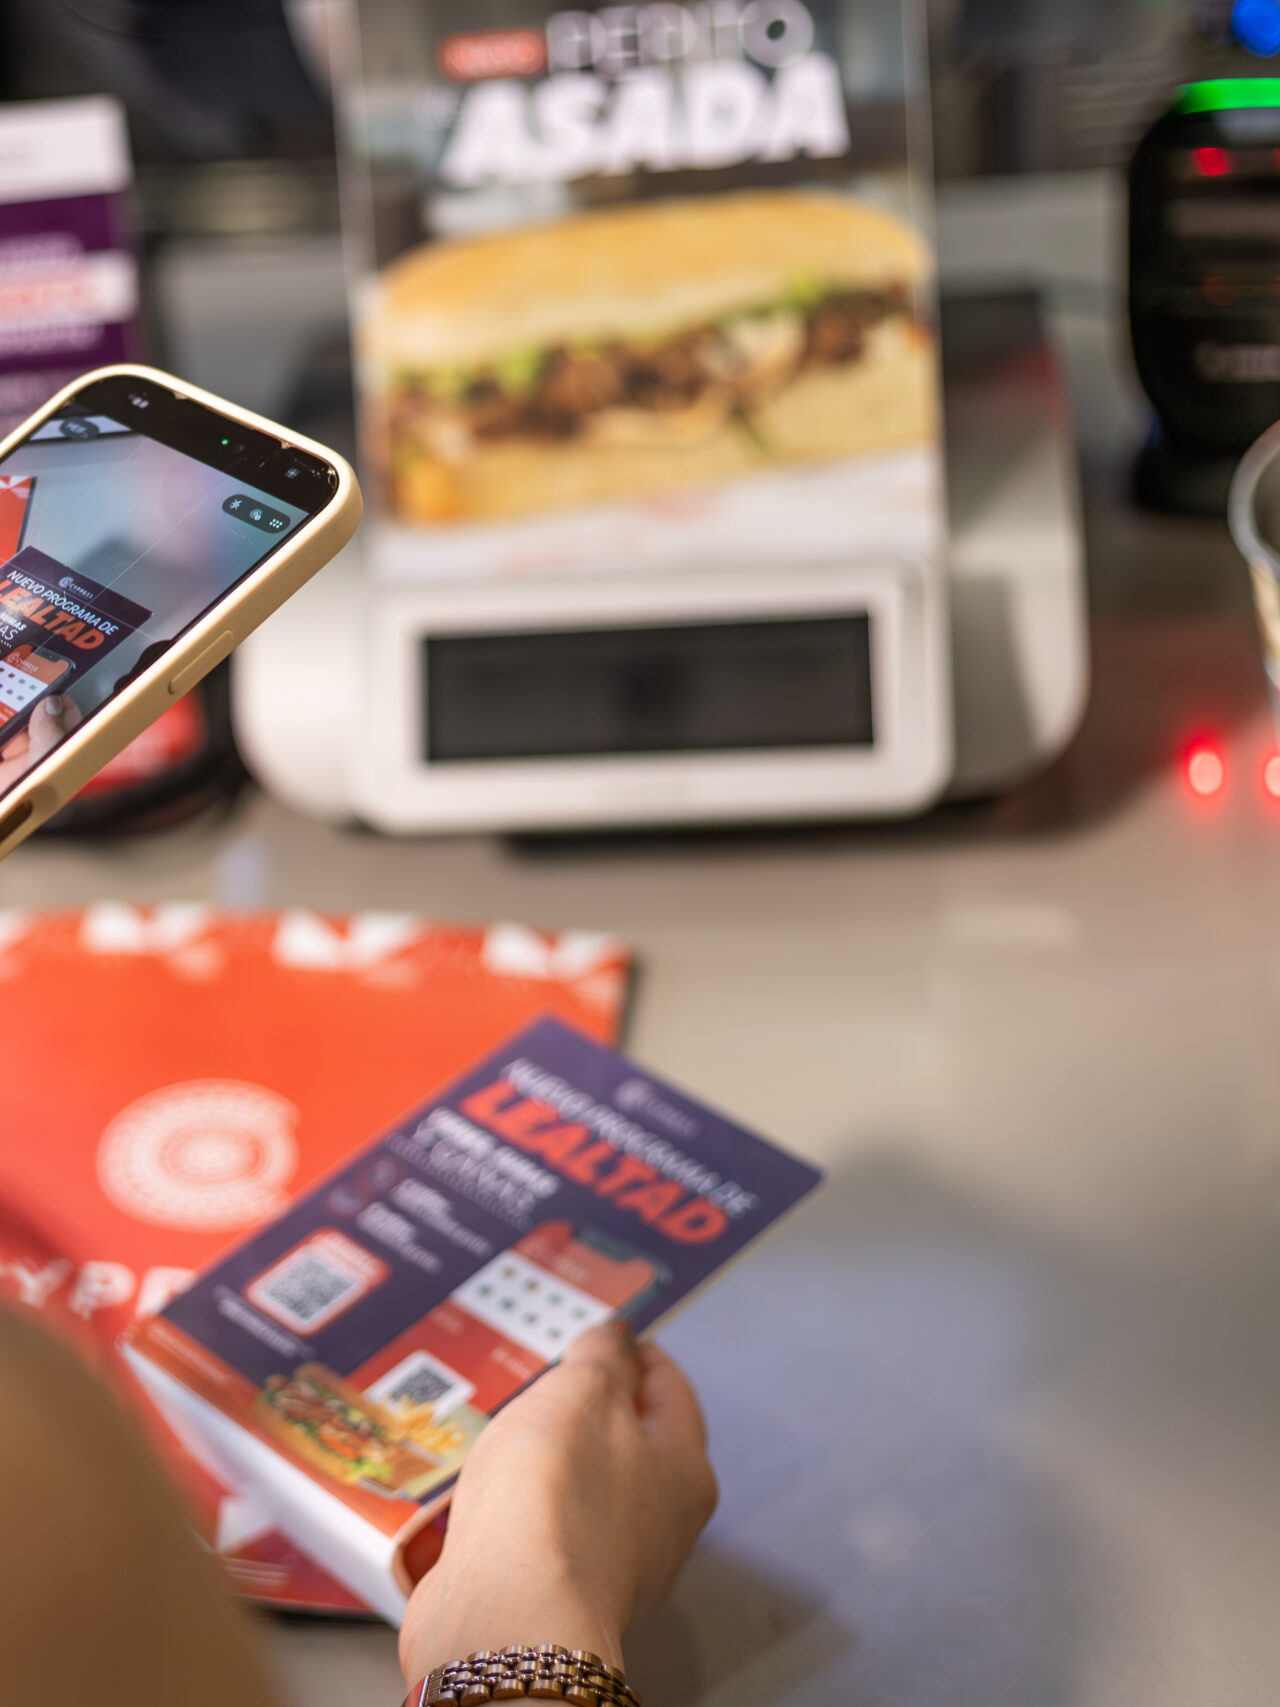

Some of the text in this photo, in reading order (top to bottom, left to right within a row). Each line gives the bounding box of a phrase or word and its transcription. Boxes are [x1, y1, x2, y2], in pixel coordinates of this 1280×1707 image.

[440, 52, 852, 188] ASADA
[7, 570, 119, 636] NUEVO PROGRAMA DE
[459, 1077, 729, 1245] LEALTAD
